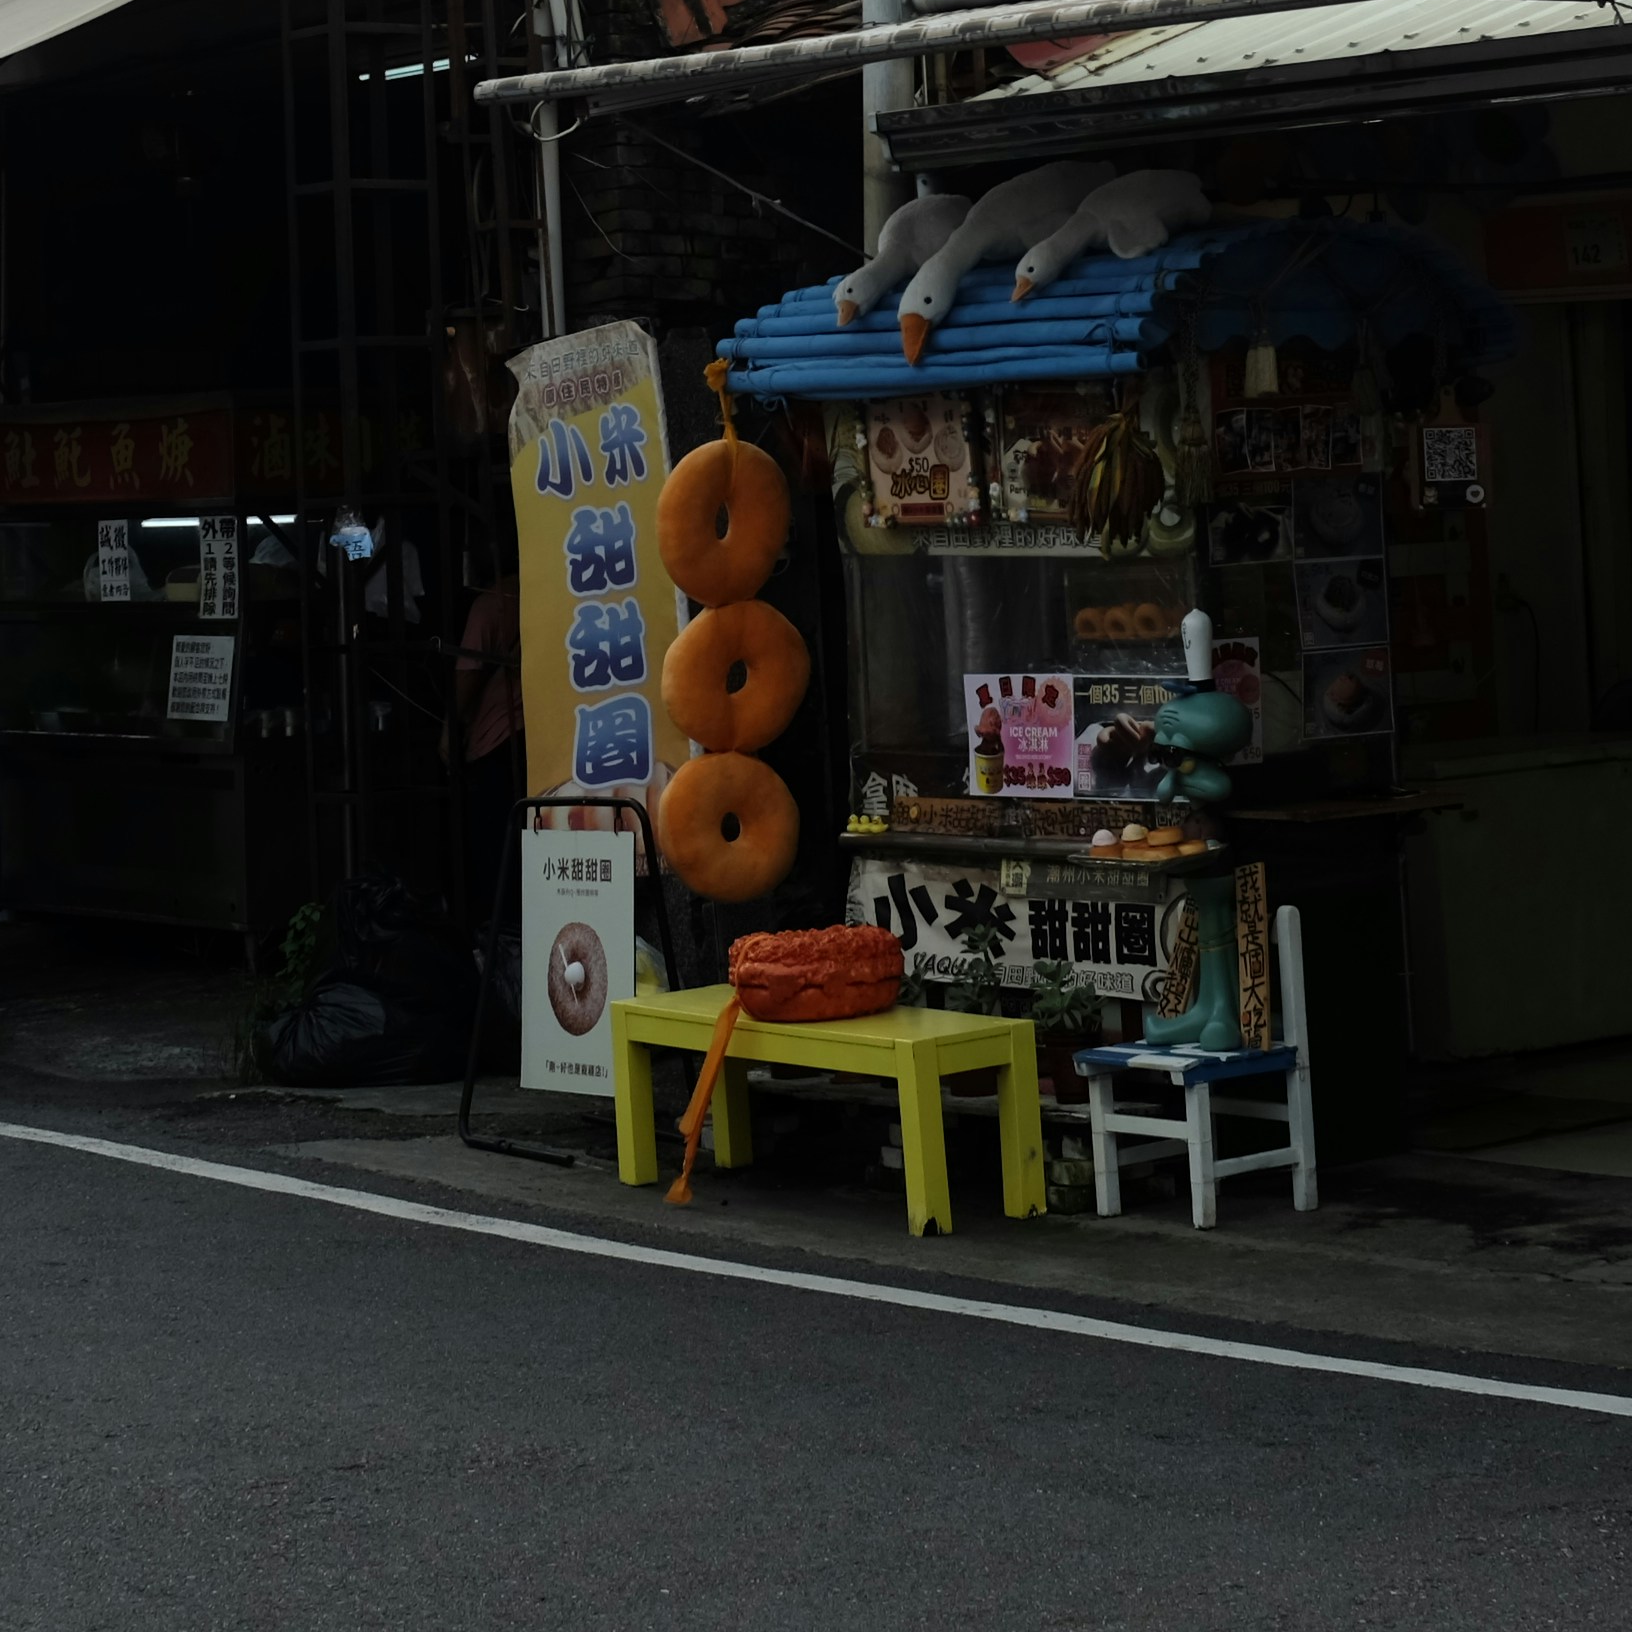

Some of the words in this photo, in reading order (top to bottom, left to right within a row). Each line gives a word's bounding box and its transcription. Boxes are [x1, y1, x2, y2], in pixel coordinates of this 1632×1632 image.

[1572, 243, 1602, 266] 142
[536, 402, 649, 498] 小米
[909, 457, 929, 472] $50
[202, 518, 235, 539] 外帶
[564, 501, 654, 788] 甜甜圈
[1075, 684, 1120, 704] 一個35
[1009, 727, 1023, 737] ICE
[1025, 726, 1058, 737] CREAM
[543, 857, 611, 882] 小米甜甜圈
[1046, 865, 1150, 888] 潮州小米甜甜圈
